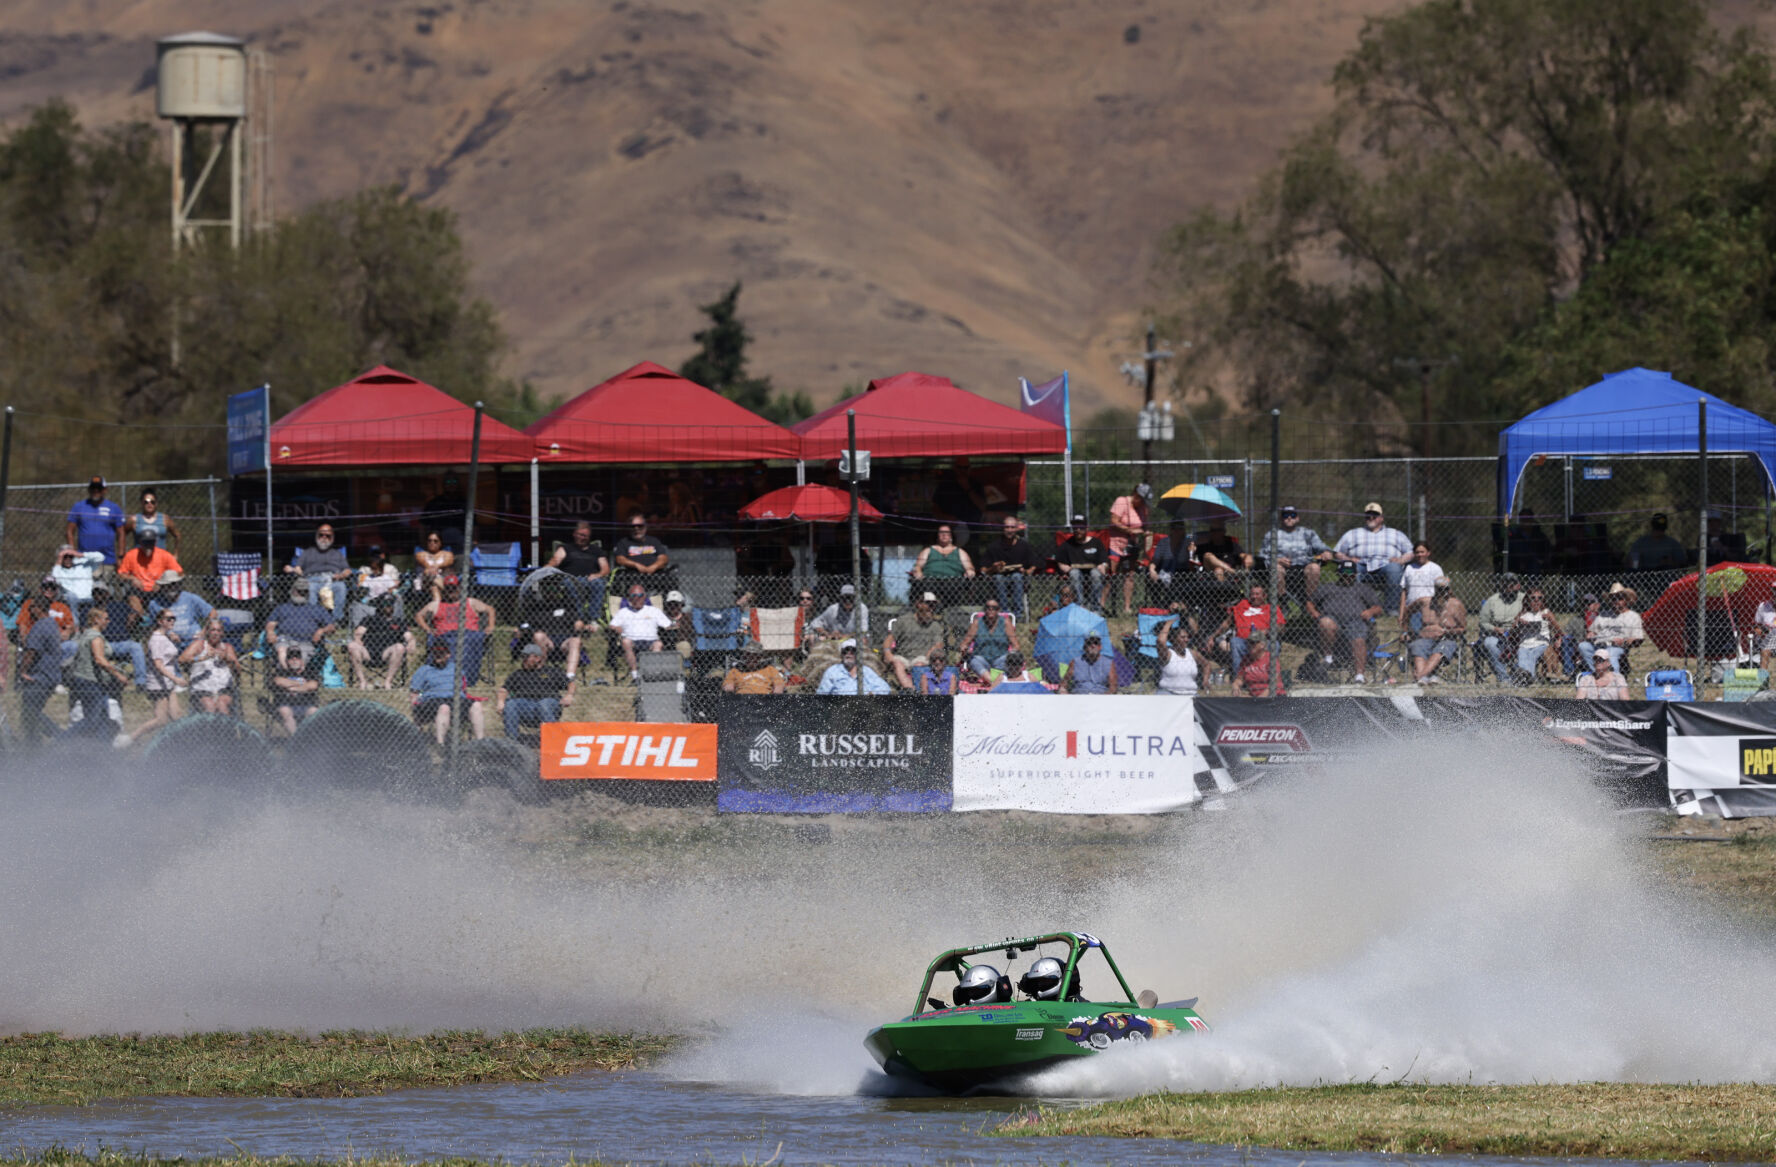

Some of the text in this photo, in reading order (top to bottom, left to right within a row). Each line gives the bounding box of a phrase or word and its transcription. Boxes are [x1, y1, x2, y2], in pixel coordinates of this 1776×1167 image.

[1555, 719, 1650, 732] EquipmentShare
[1220, 729, 1297, 742] PENDLETON
[799, 733, 923, 756] RUSSELL
[957, 733, 1187, 757] Michelob ULTRA
[559, 735, 699, 768] STIHL
[811, 758, 910, 768] LANDSCAPING
[989, 769, 1155, 780] SUPERIOR LIGHT BEER
[1016, 1028, 1044, 1040] Transag
